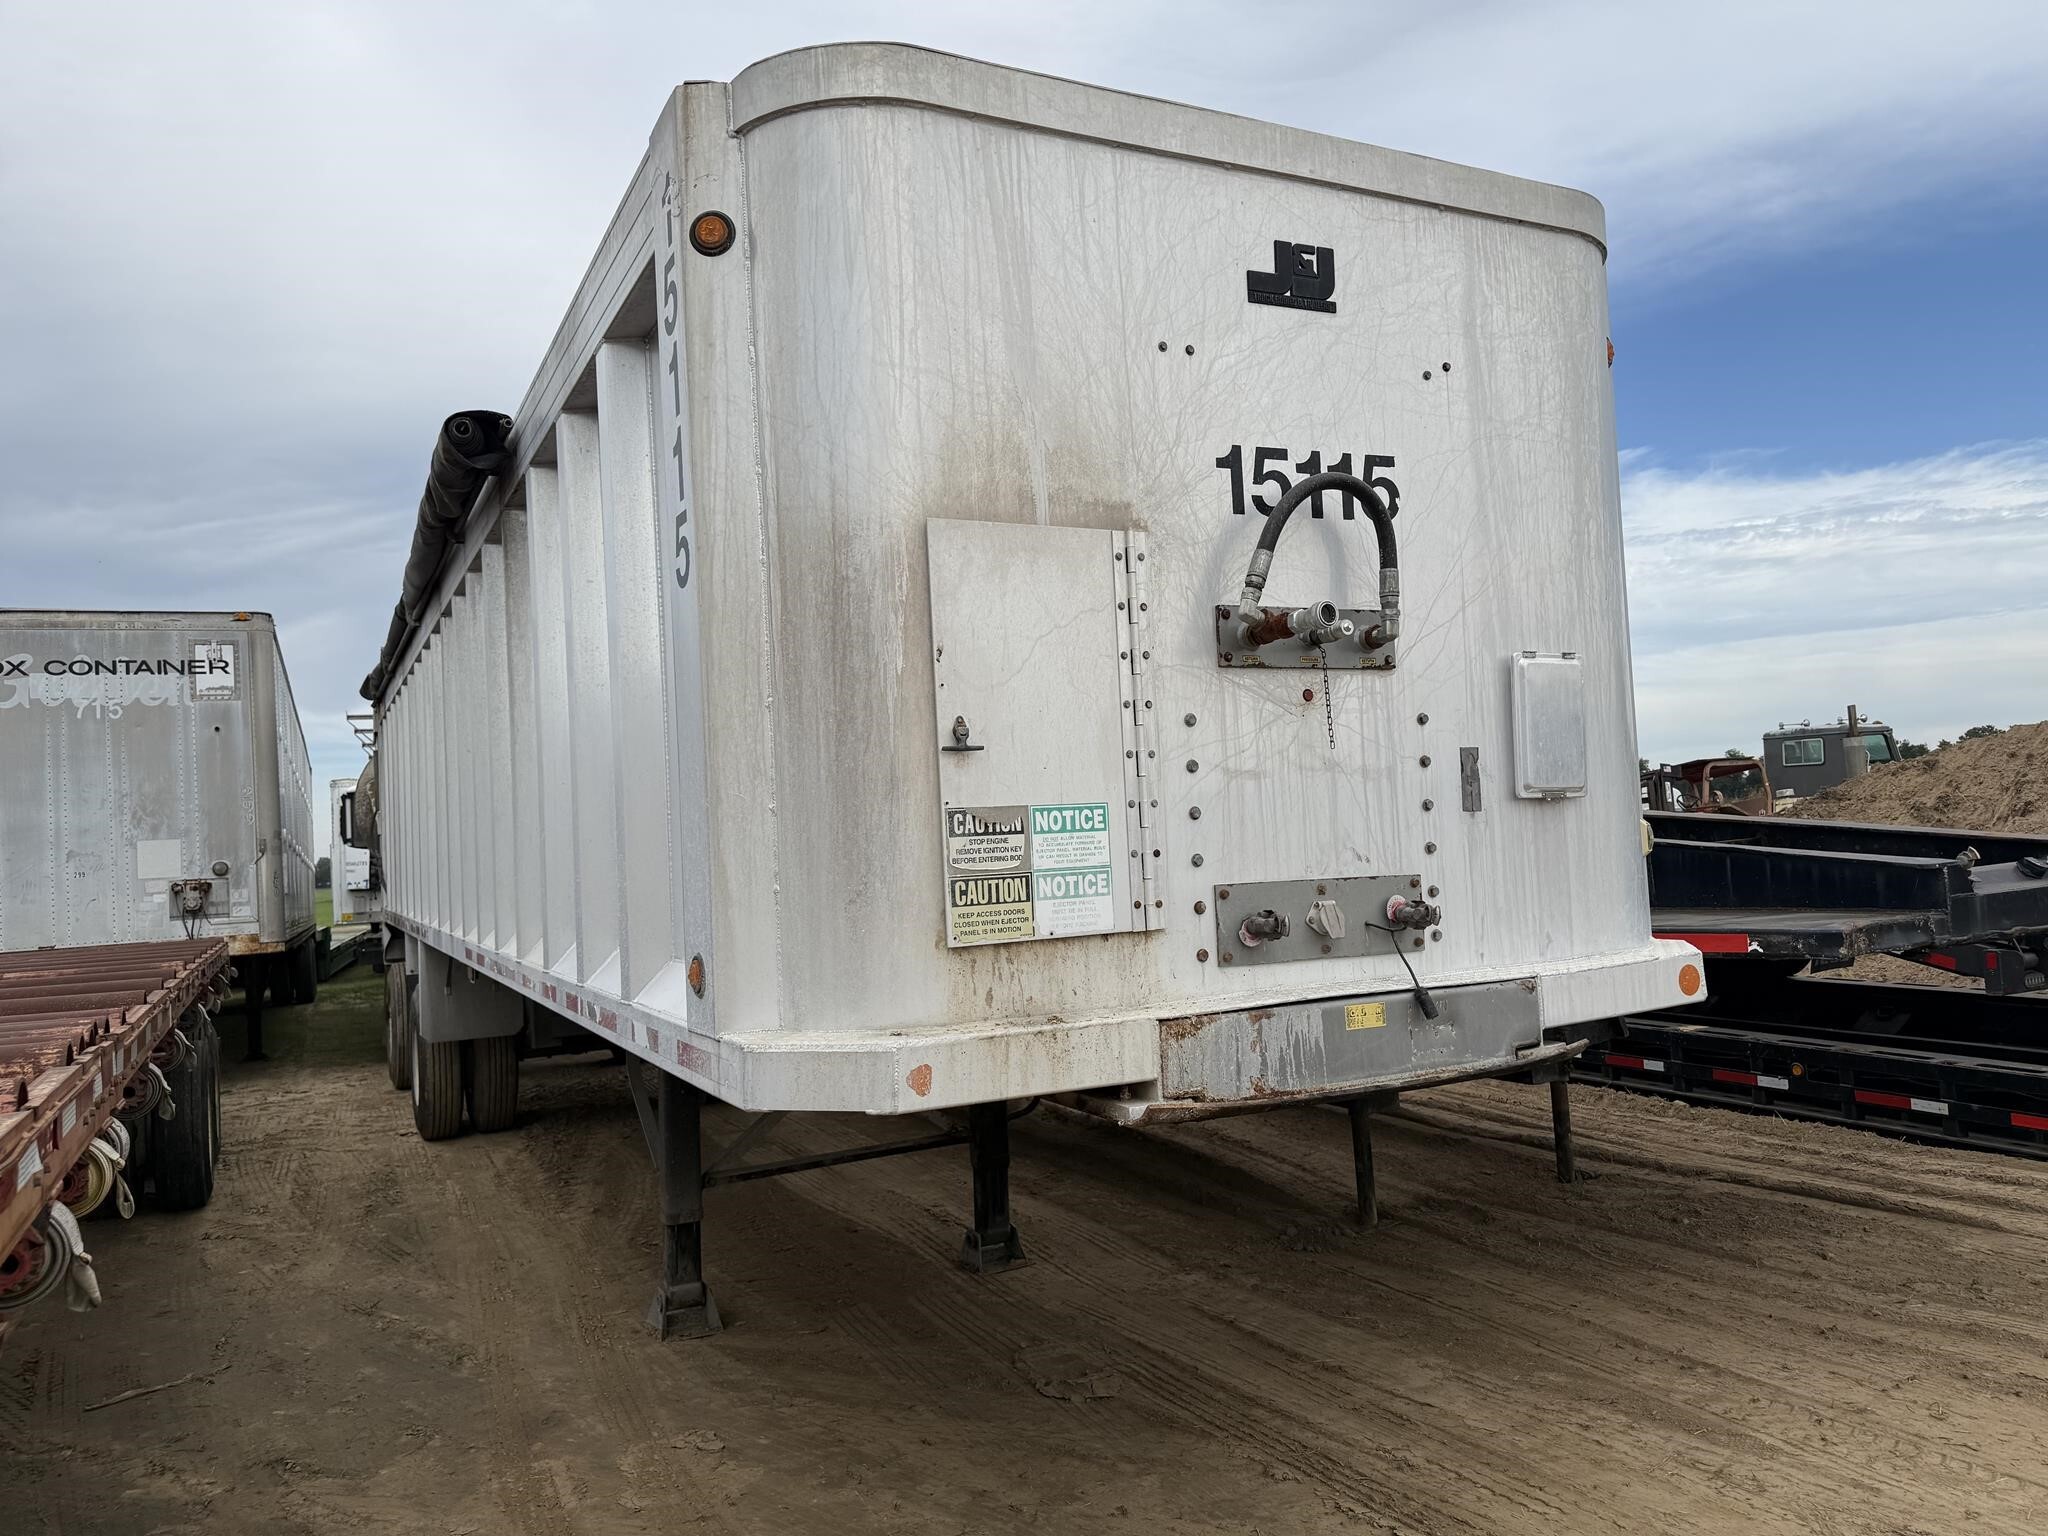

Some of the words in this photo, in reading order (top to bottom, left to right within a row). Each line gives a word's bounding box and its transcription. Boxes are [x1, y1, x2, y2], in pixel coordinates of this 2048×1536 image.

[1216, 444, 1400, 521] 15115
[43, 659, 231, 676] CONTAINER
[76, 703, 123, 719] 715
[1035, 808, 1105, 832] NOTICE
[968, 838, 986, 846] STOP
[986, 837, 1009, 845] ENGINE
[955, 847, 982, 855] REMOVE
[983, 846, 1010, 854] IGNITION
[1010, 845, 1023, 853] KEY
[951, 857, 978, 865] BEFORE
[978, 855, 1009, 863] ENTERING
[1009, 854, 1023, 862] BOD
[954, 877, 1027, 906] CAUTION
[1038, 873, 1108, 898] NOTICE
[976, 910, 1002, 918] ACCESS
[1003, 908, 1026, 916] DOORS
[953, 920, 980, 928] CLOSED
[1000, 916, 1029, 925] EJECTOR
[997, 926, 1022, 934] MOTION
